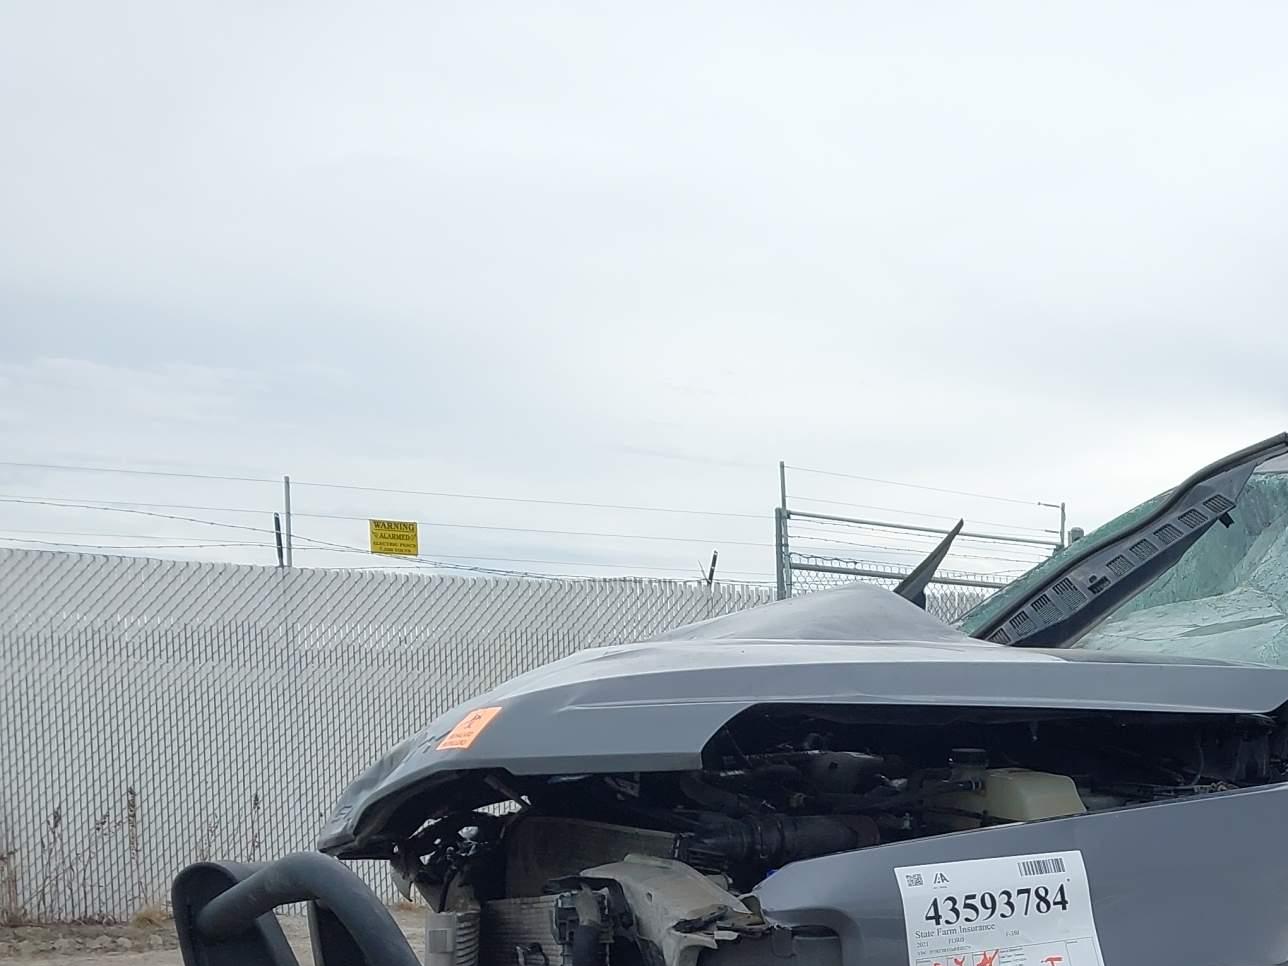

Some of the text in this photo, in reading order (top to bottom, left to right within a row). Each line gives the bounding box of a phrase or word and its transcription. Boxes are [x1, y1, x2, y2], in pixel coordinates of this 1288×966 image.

[373, 520, 415, 531] WARNING
[925, 883, 1069, 926] 43593784
[915, 922, 996, 939] State Farm Insurance
